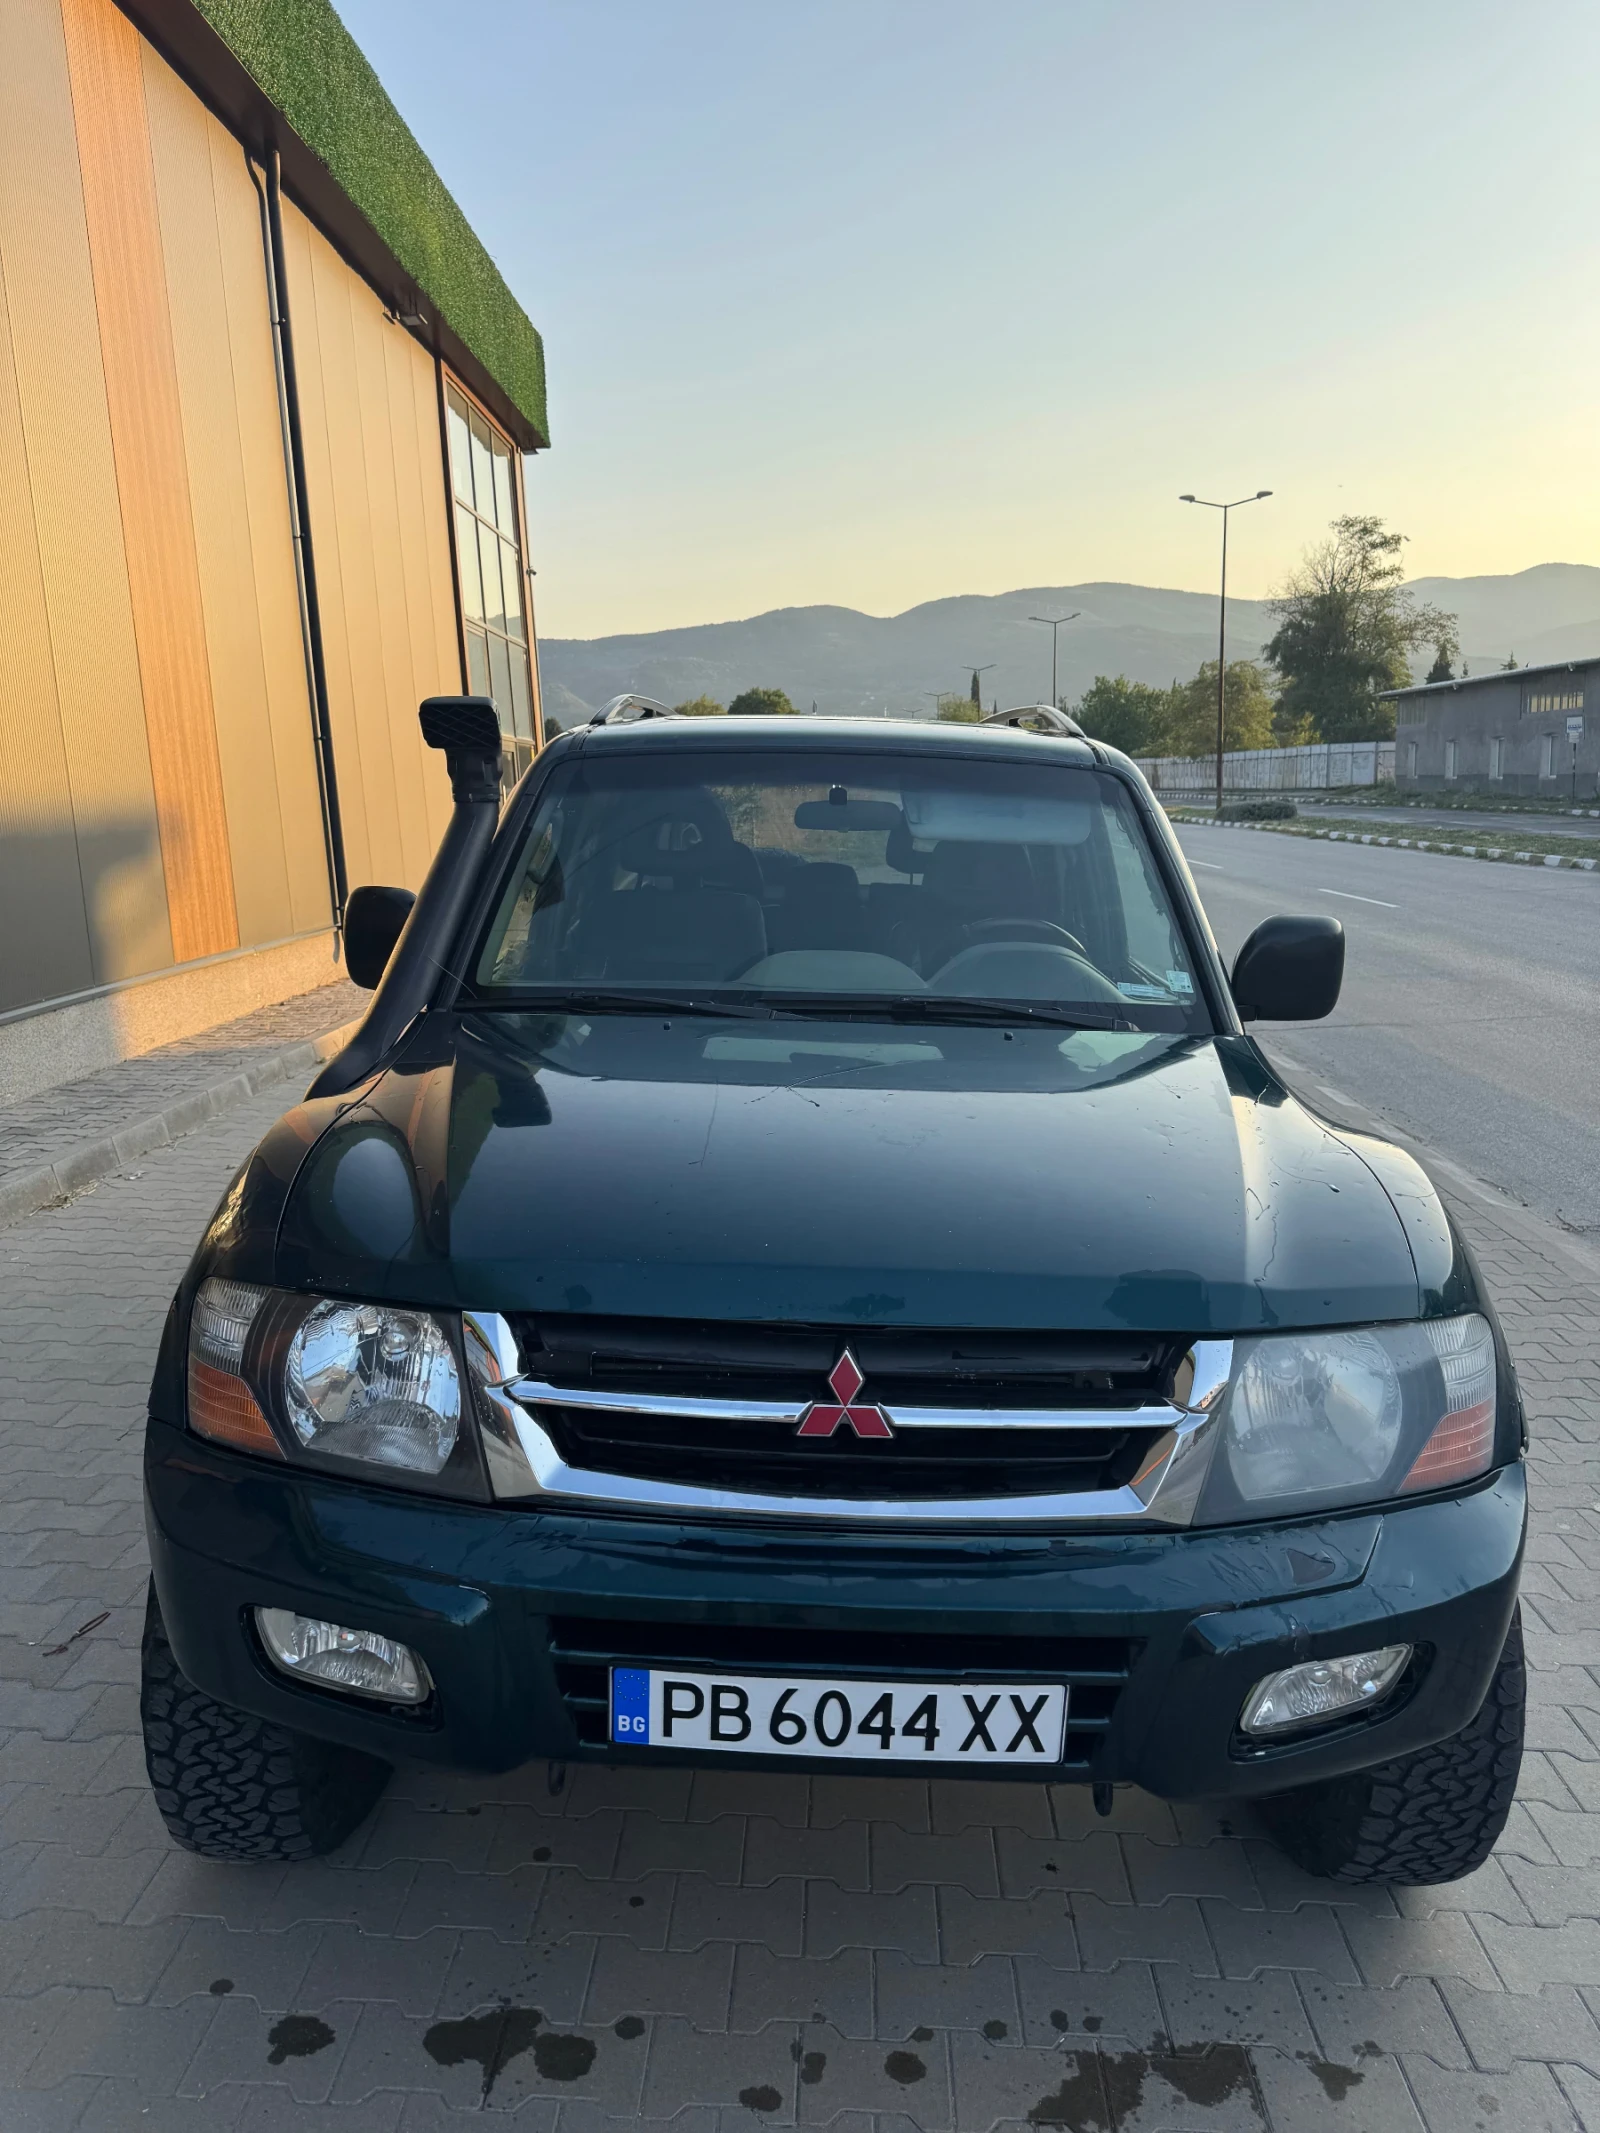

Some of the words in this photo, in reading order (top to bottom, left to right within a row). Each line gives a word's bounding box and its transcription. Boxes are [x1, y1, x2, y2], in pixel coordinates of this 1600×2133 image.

[617, 1715, 646, 1733] BG
[662, 1680, 752, 1742] PB
[769, 1688, 940, 1752] 6044
[958, 1694, 1050, 1753] XX
